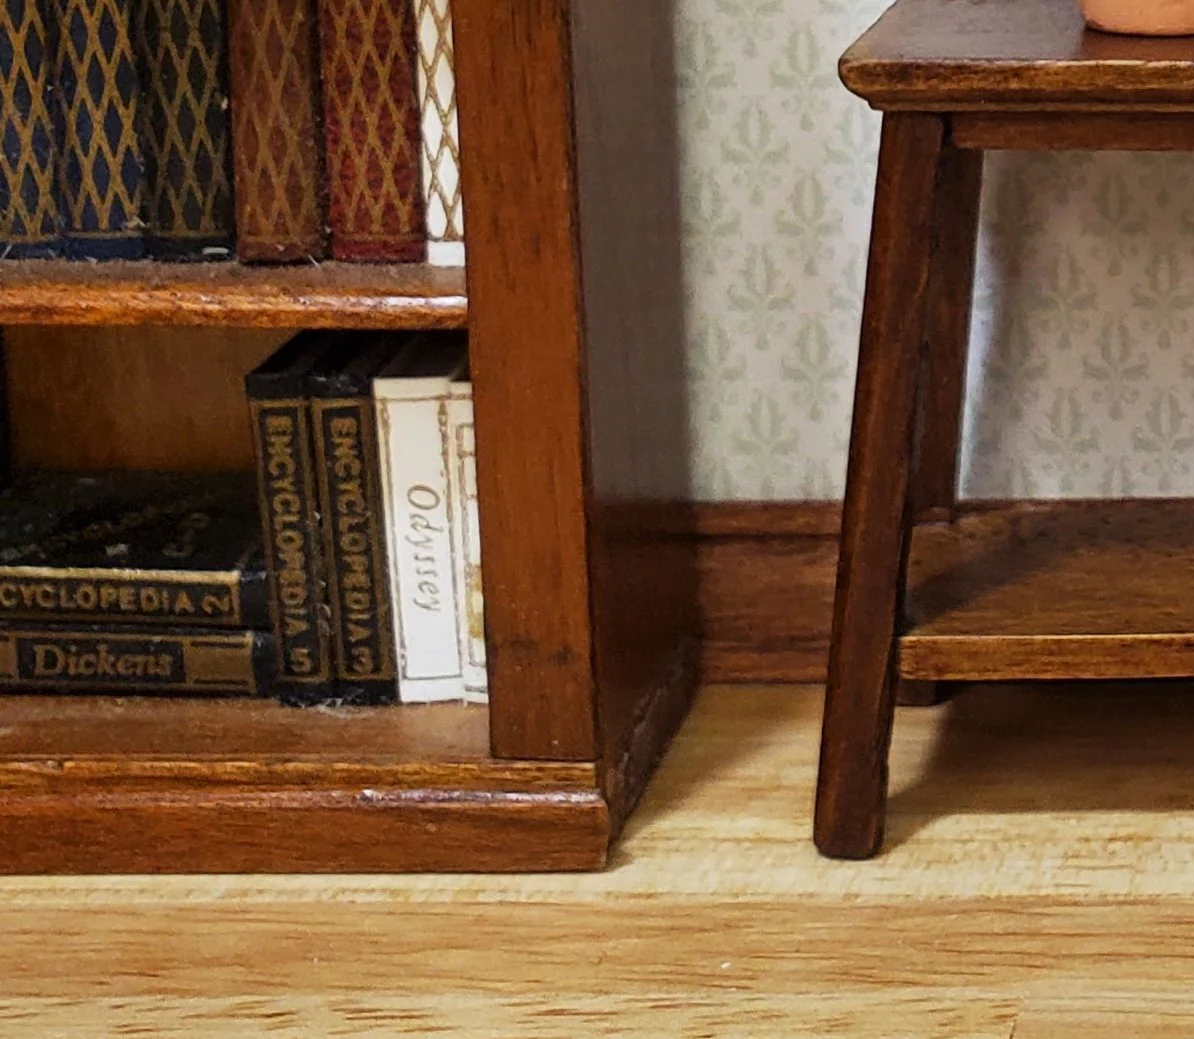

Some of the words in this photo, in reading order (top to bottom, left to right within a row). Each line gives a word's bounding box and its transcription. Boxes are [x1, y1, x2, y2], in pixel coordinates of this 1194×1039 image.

[266, 415, 311, 637] ENCYCLOPEDIA
[290, 646, 313, 674] 5
[329, 415, 373, 642] ENCYCLOPEDIA
[405, 484, 445, 613] Odyssey
[33, 642, 175, 677] Dickens
[350, 646, 373, 674] 3
